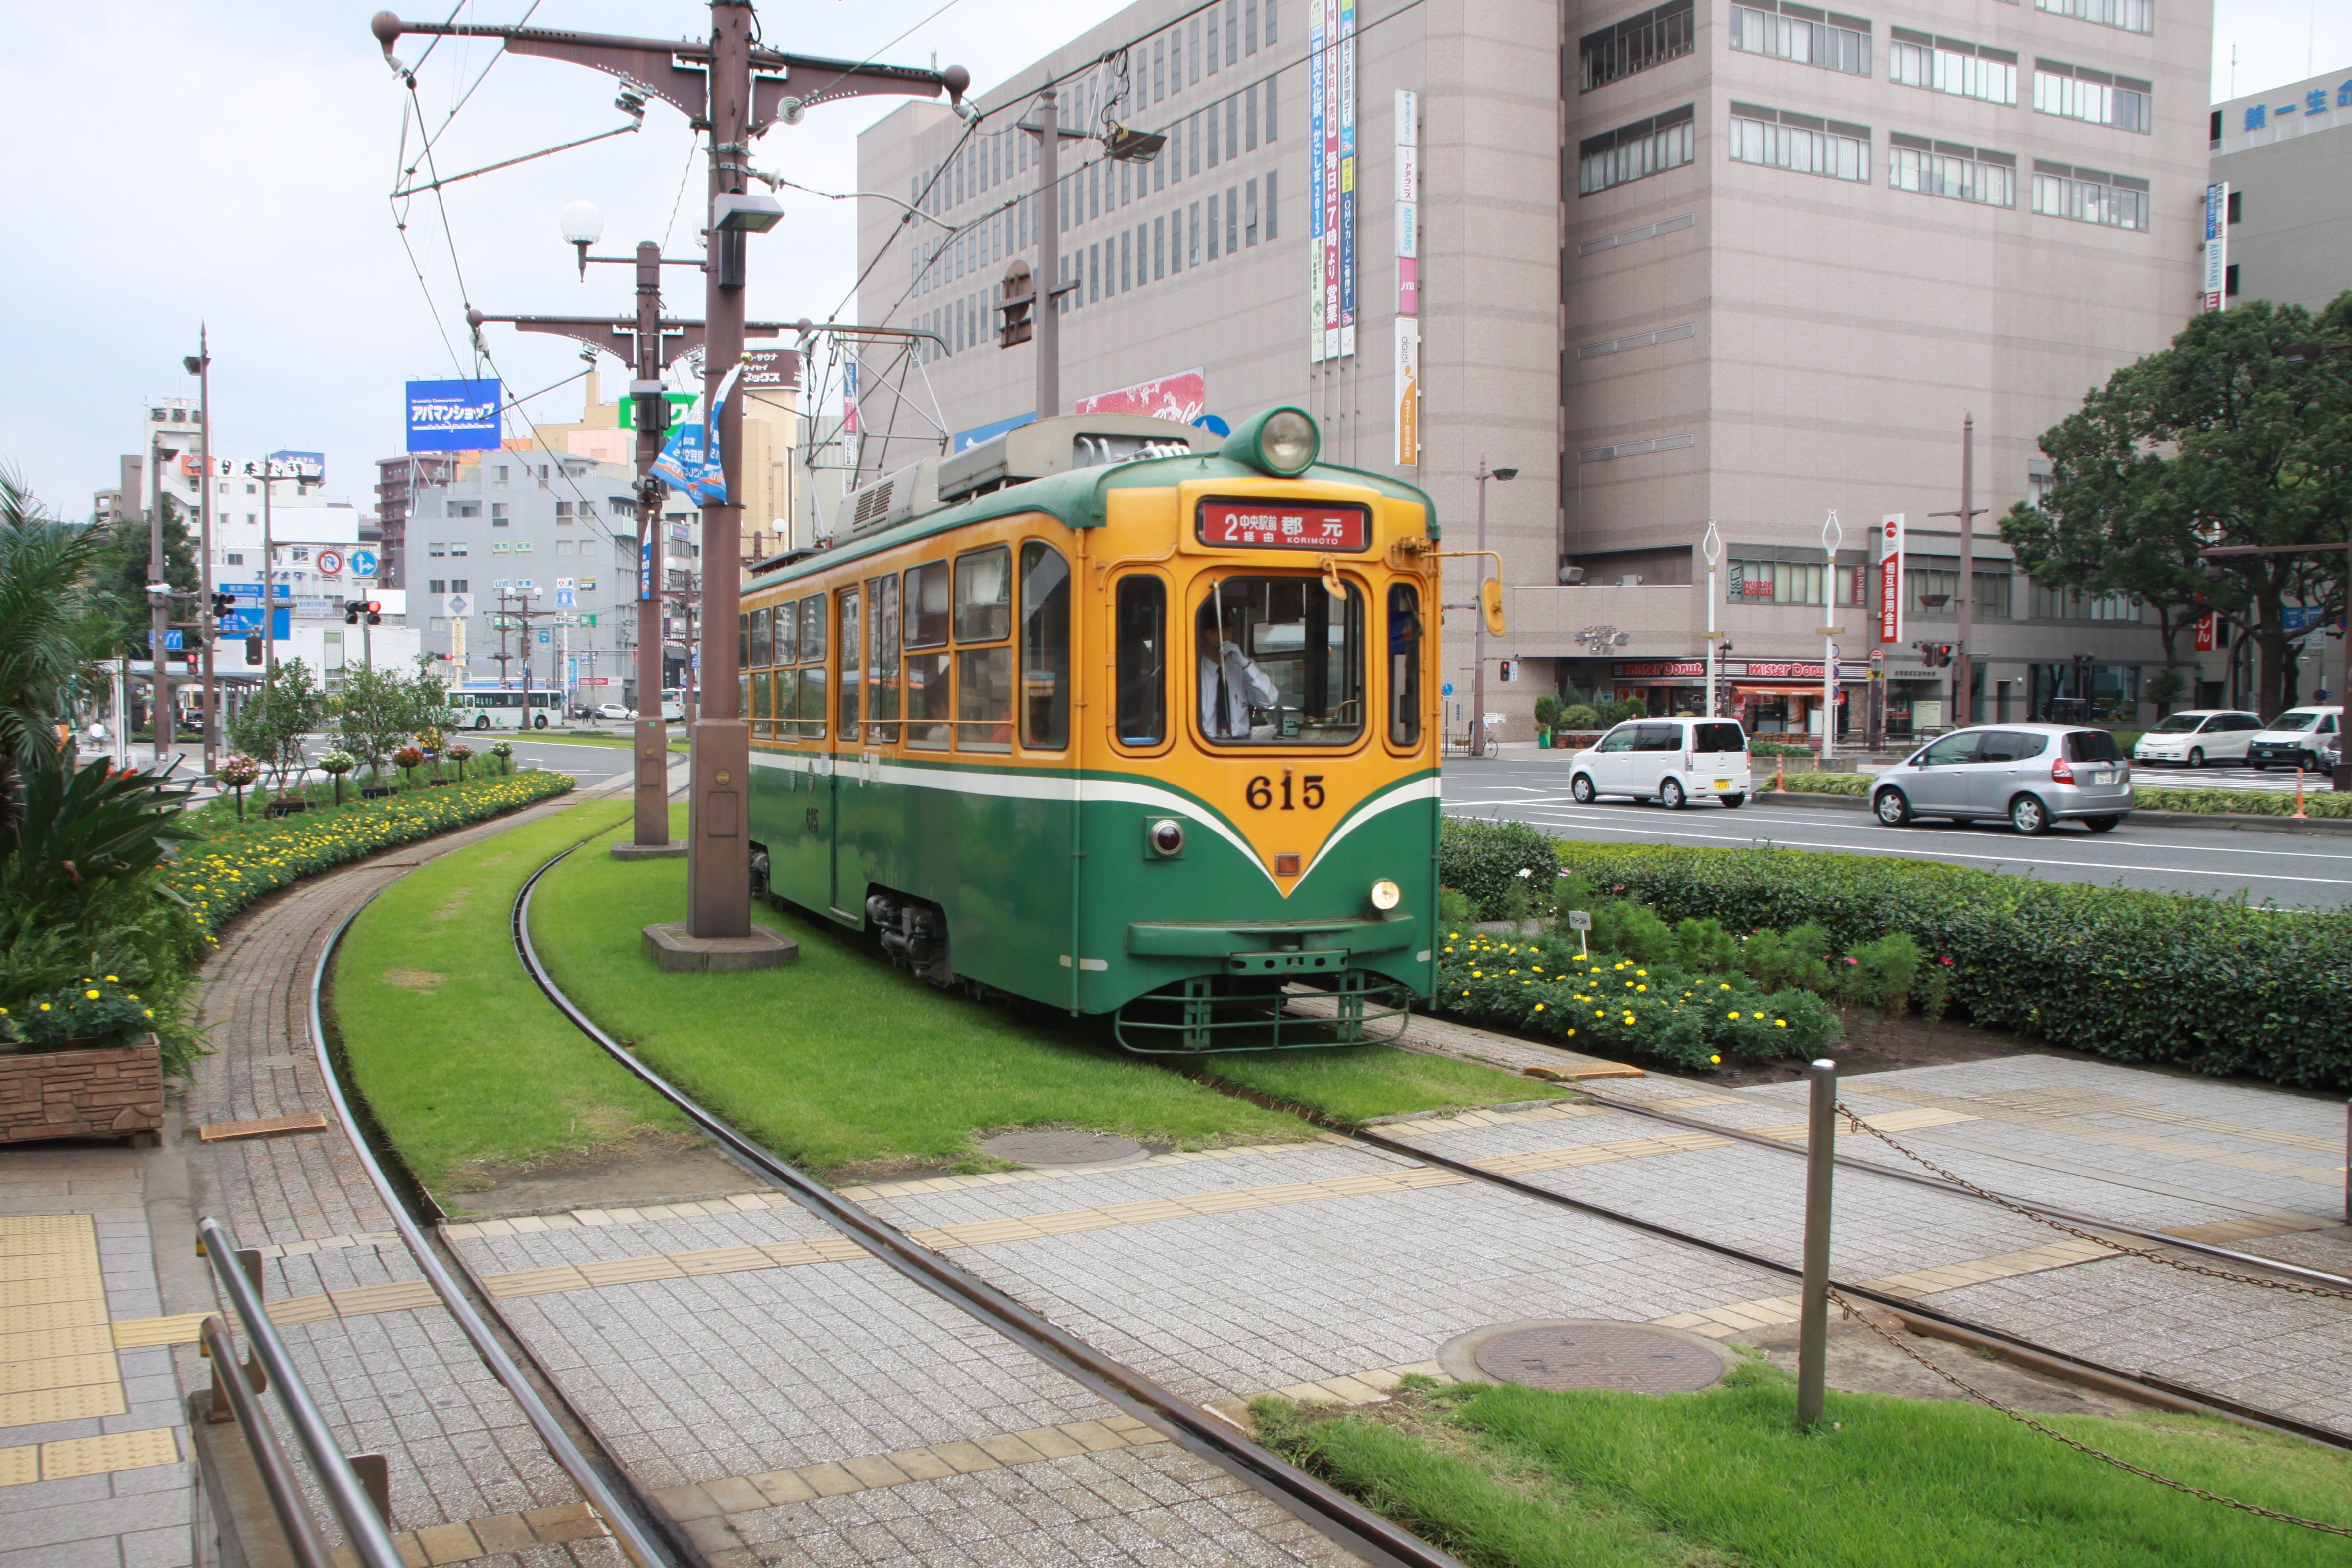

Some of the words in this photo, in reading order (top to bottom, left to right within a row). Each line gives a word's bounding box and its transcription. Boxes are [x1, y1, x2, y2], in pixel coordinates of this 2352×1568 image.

[1403, 207, 1412, 251] ADERANS
[2209, 244, 2219, 288] ADERANS
[751, 353, 778, 361] ・サウナ
[1402, 337, 1410, 364] daiei
[412, 403, 495, 422] アパマンショップ
[1225, 514, 1238, 541] 2
[1240, 514, 1277, 531] 中央駅前
[1287, 537, 1338, 545] KORIMOTO
[1744, 587, 1773, 596] Donut
[1884, 562, 1895, 637] 相互信用金庫
[1663, 662, 1704, 676] Donut
[1792, 663, 1826, 677] Donu
[1246, 774, 1325, 811] 615
